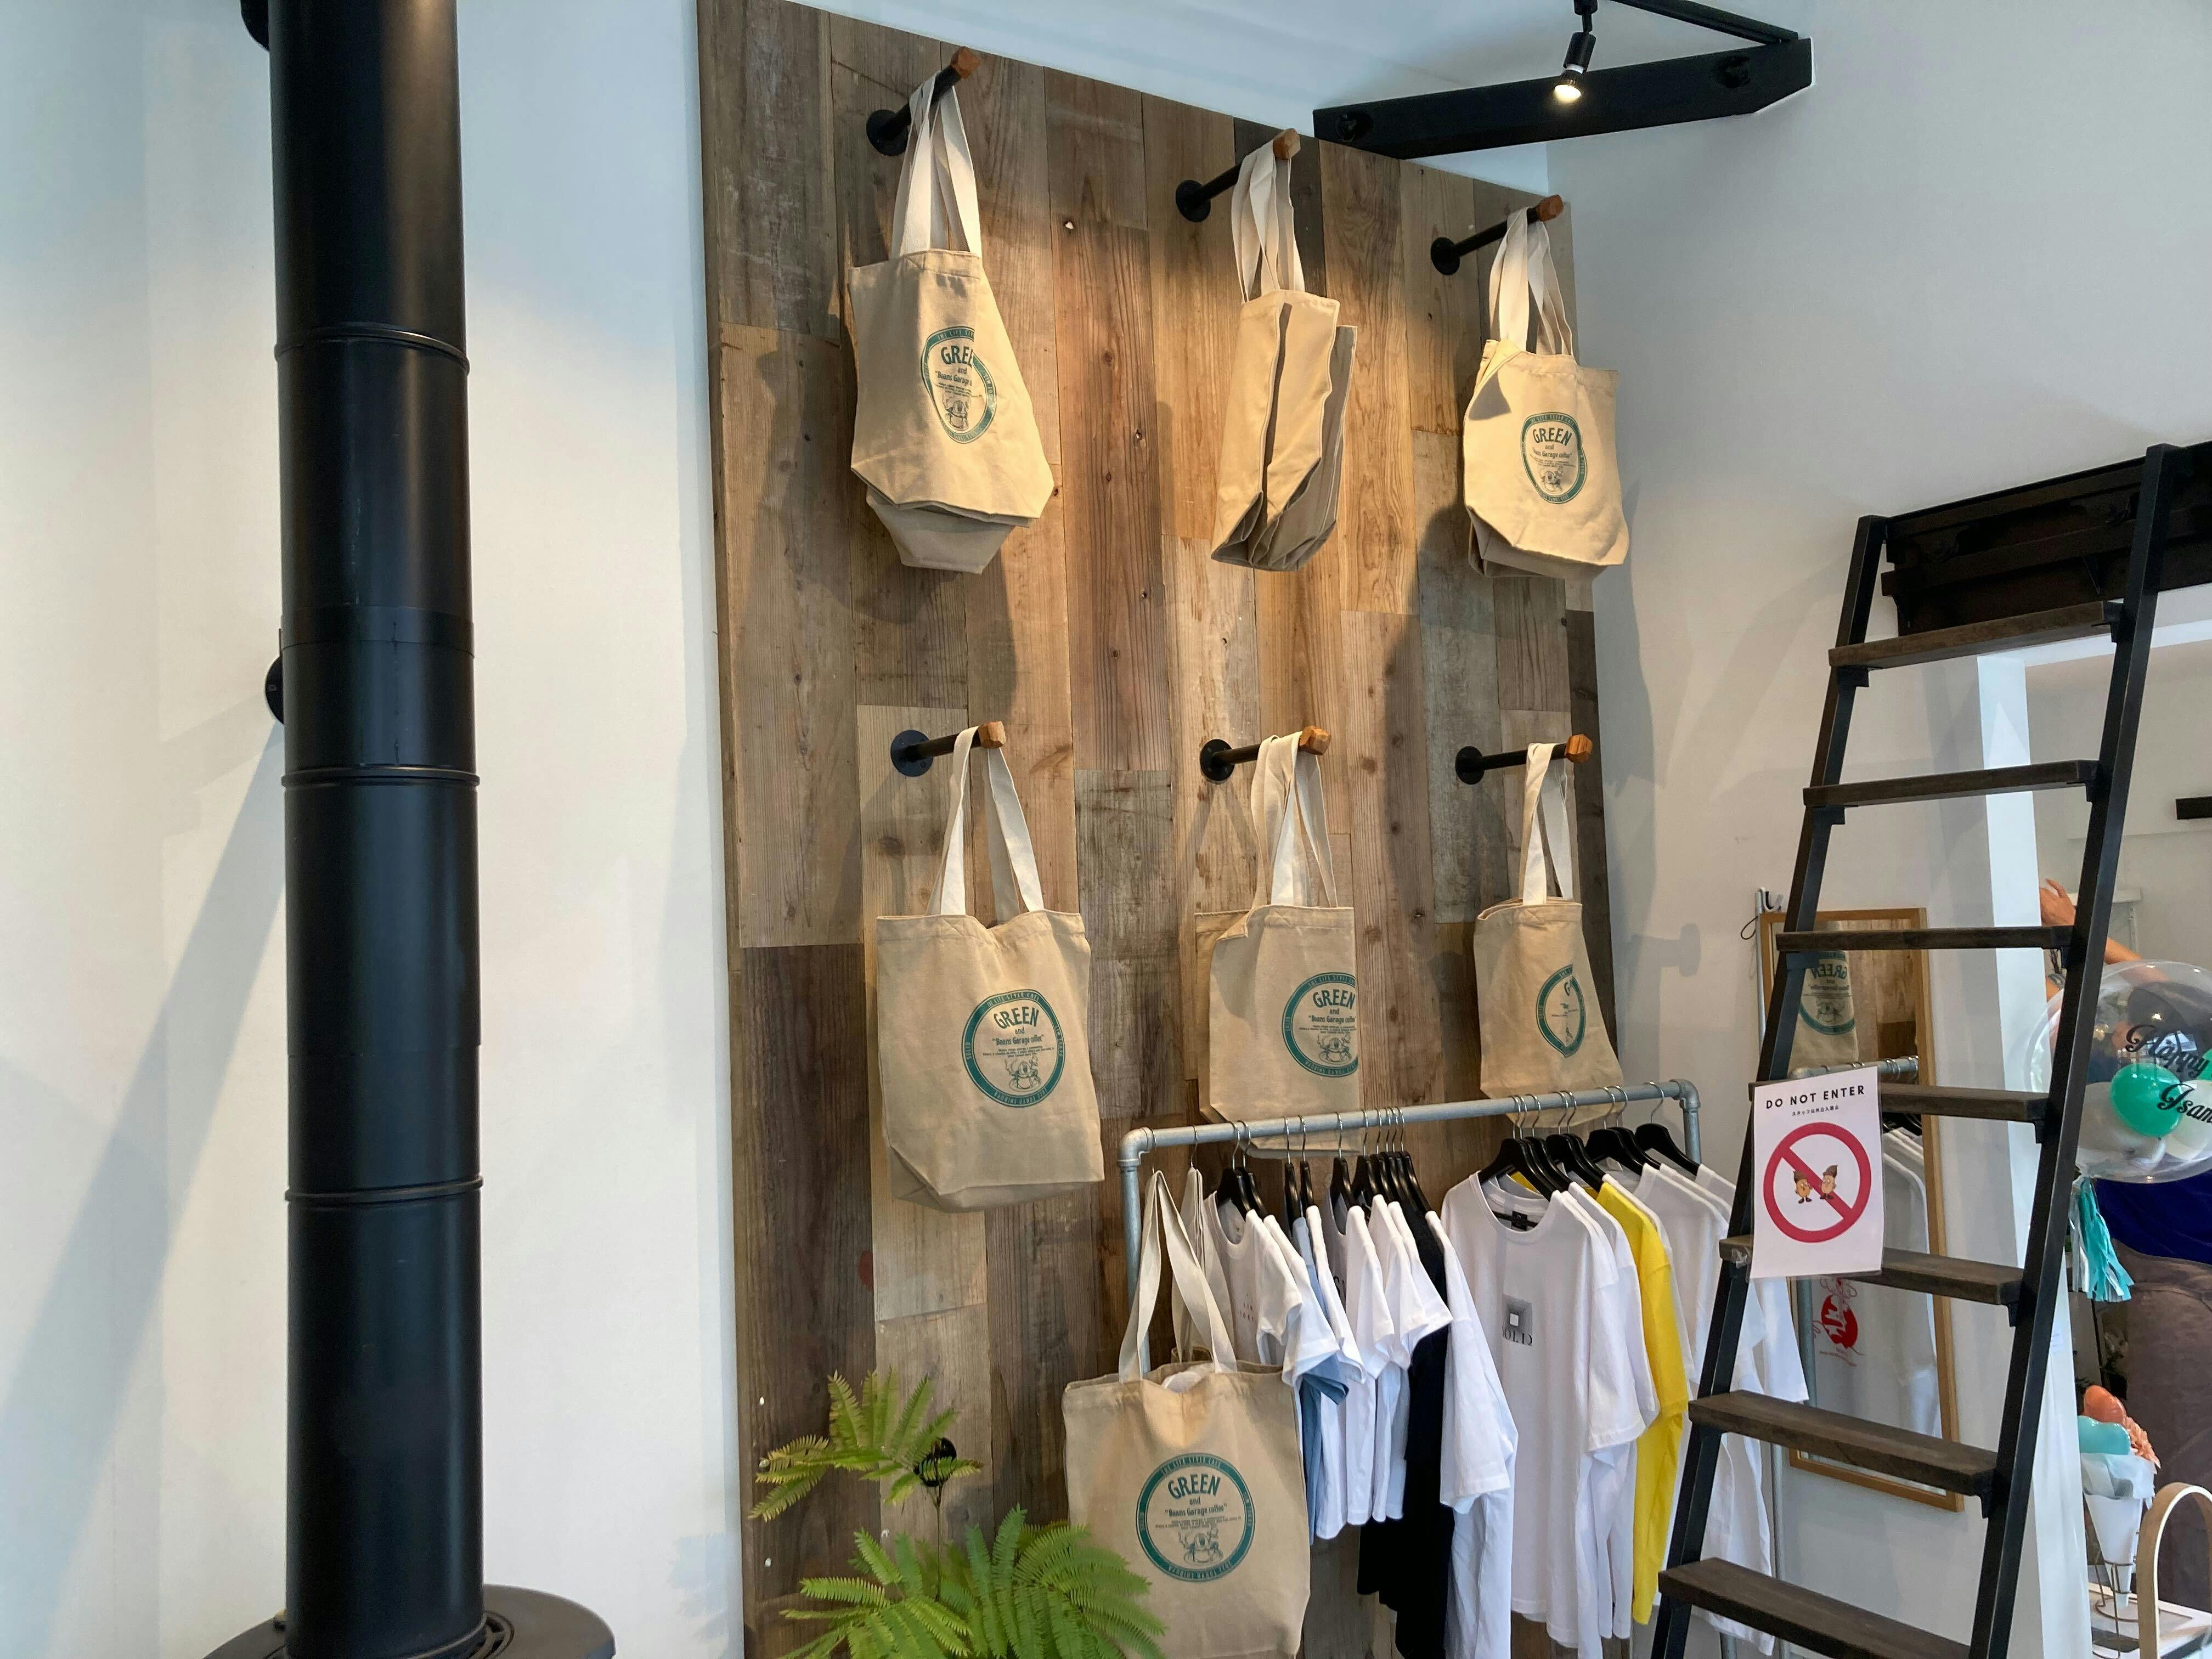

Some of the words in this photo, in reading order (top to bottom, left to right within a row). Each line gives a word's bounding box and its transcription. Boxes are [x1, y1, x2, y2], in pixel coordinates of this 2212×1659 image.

[1533, 427, 1572, 447] GREEN
[1313, 989, 1355, 1009] GREEN
[994, 1006, 1039, 1029] GREEN
[1327, 1015, 1344, 1024] Garage
[1013, 1036, 1030, 1045] Garage
[1766, 1098, 1783, 1109] DO
[1790, 1092, 1816, 1105] NOT
[1823, 1085, 1865, 1100] ENTER
[1168, 1474, 1221, 1499] GREEN
[1189, 1496, 1201, 1505] and
[1187, 1508, 1207, 1516] Garage
